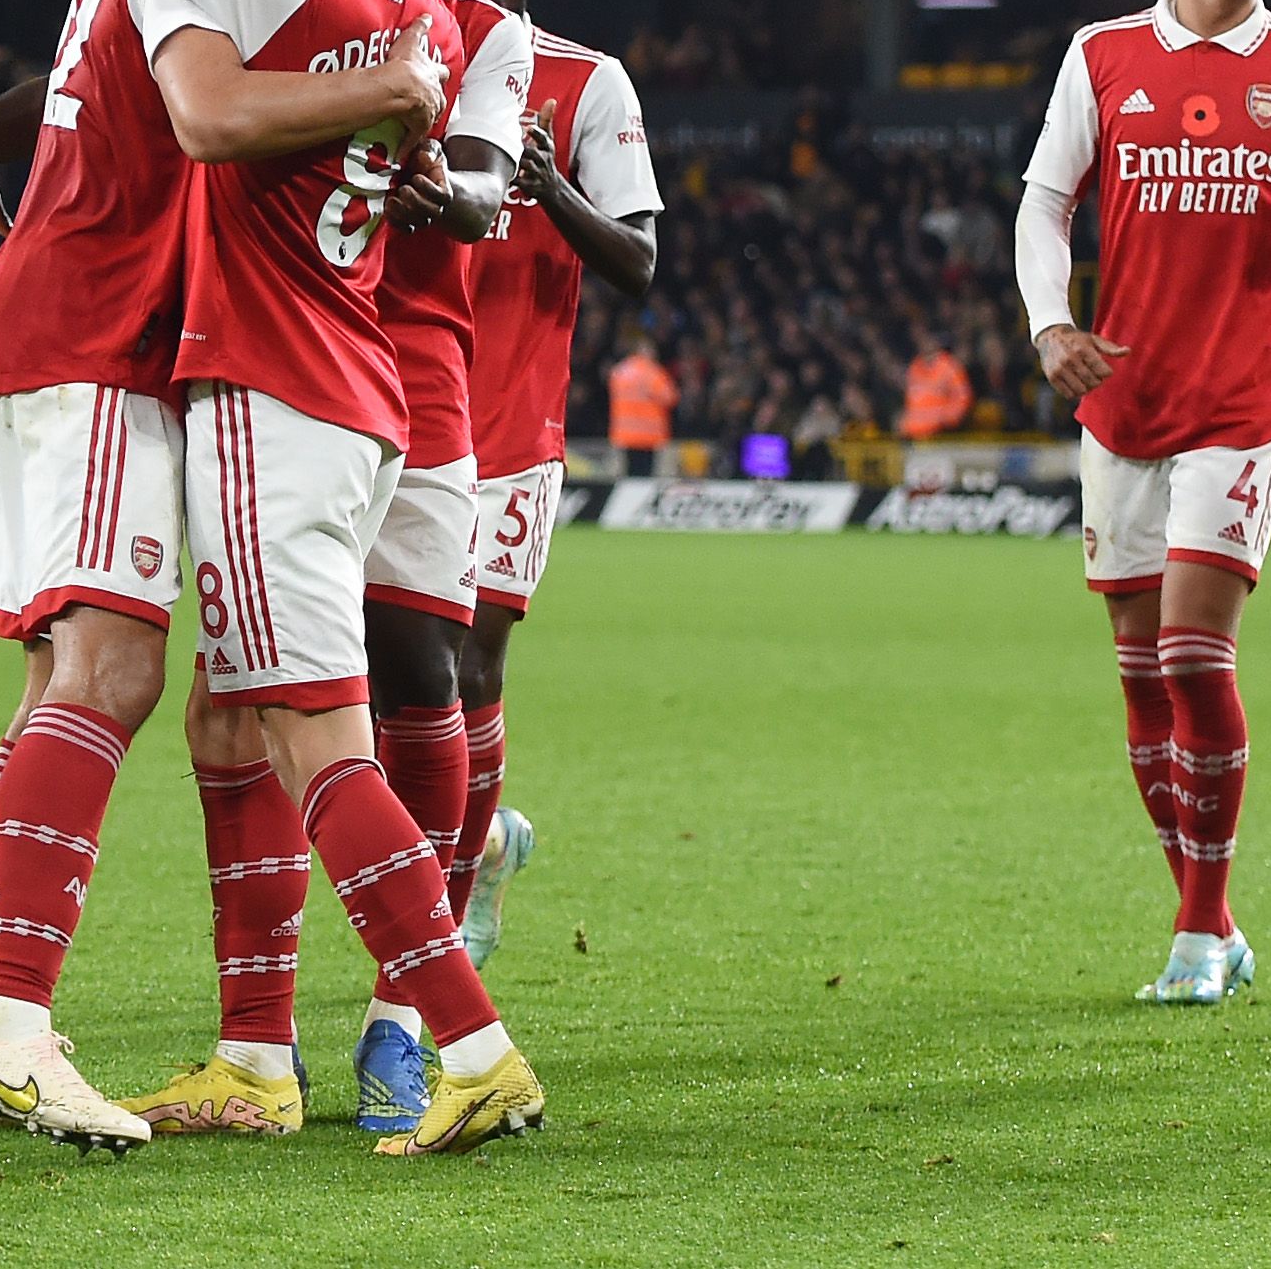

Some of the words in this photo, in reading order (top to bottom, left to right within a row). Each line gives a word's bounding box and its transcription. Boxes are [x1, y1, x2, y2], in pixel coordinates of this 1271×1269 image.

[316, 118, 397, 267] 8
[1138, 181, 1174, 212] FLY
[1178, 181, 1259, 214] BETTER
[495, 486, 530, 547] 5
[1227, 459, 1258, 518] 4
[197, 561, 228, 639] 8
